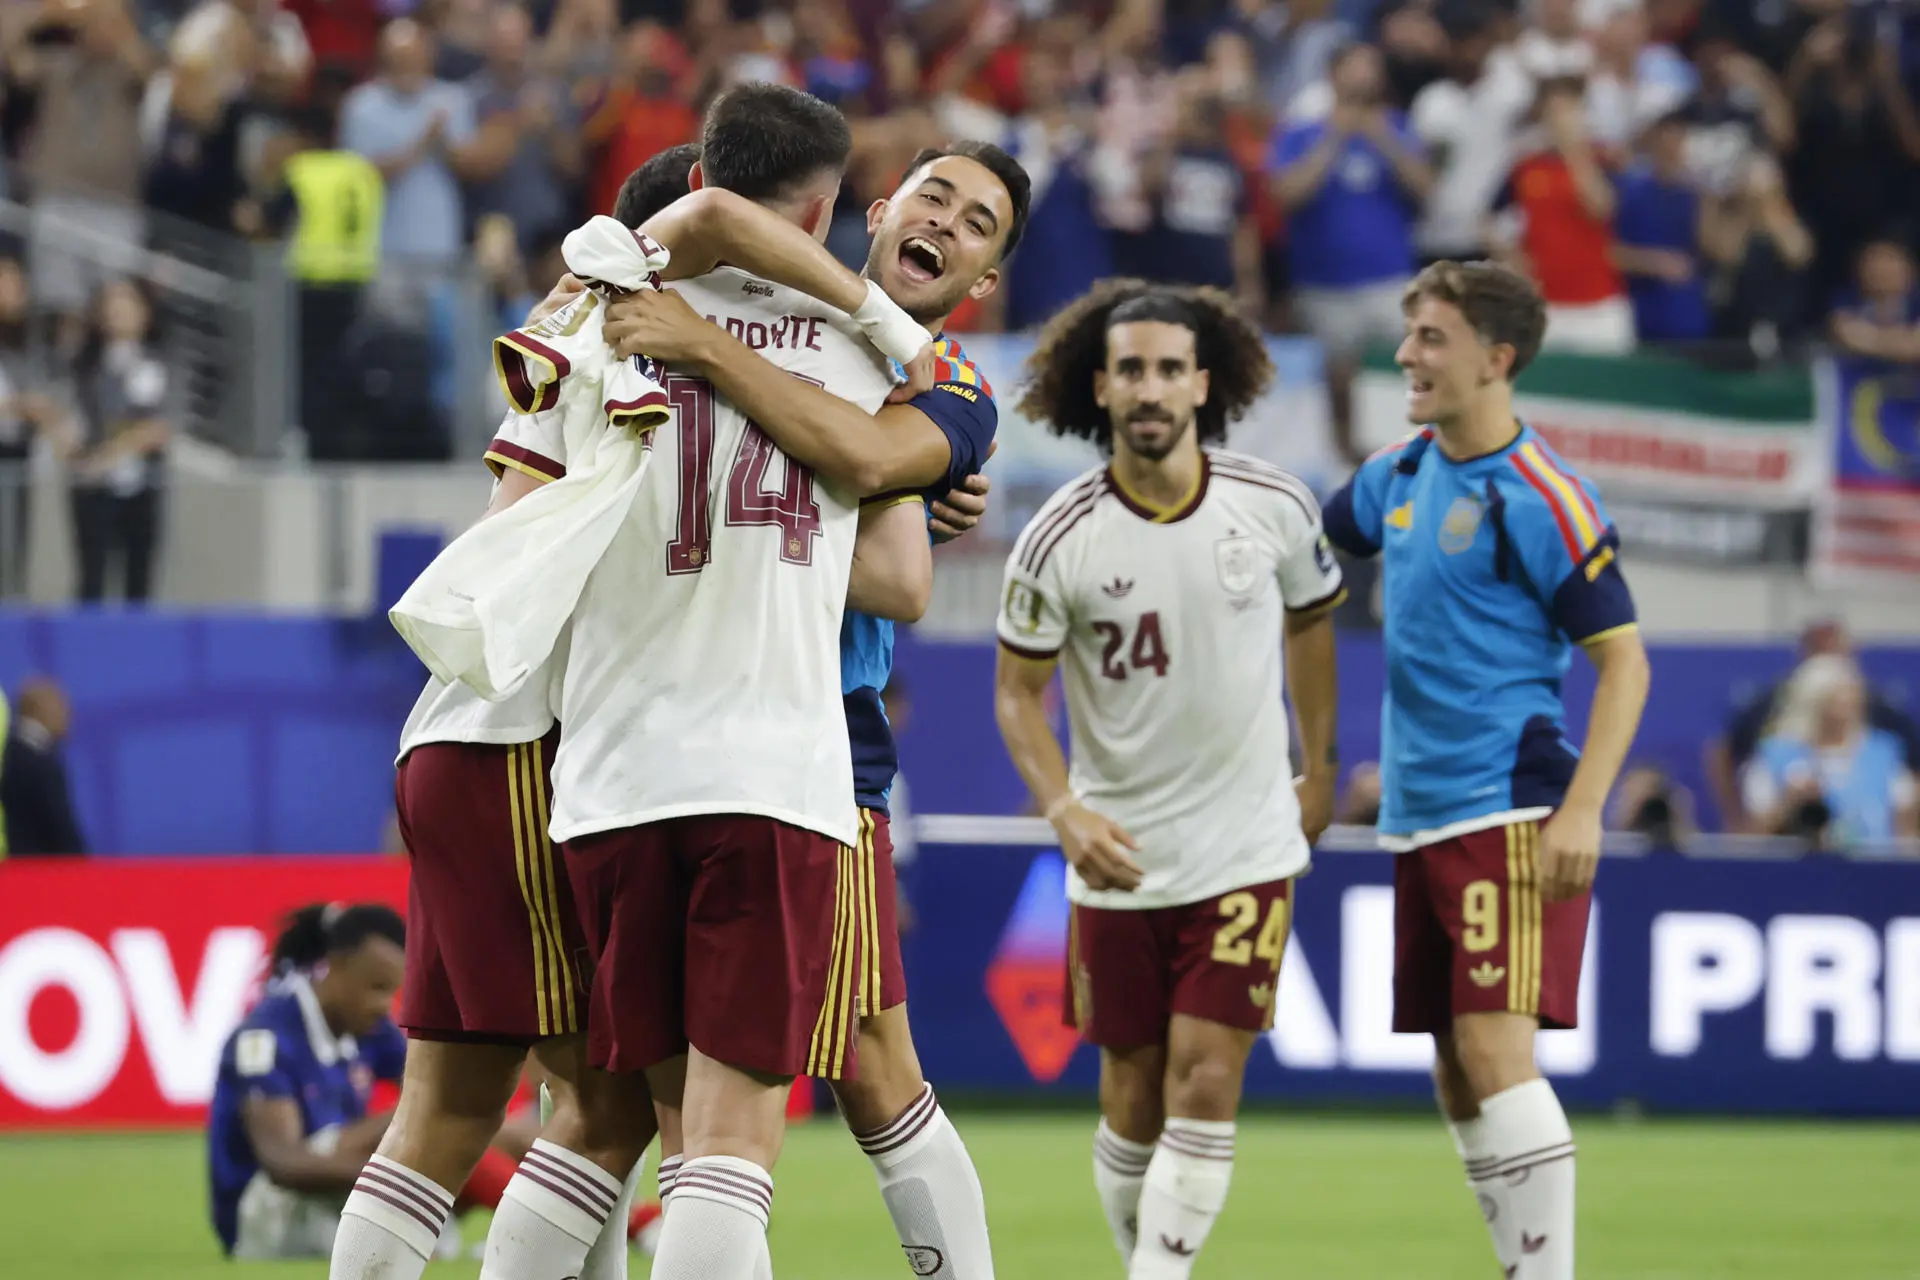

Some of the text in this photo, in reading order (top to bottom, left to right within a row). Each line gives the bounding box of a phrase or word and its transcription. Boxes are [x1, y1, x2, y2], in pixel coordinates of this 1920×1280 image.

[705, 314, 828, 352] PORTE
[666, 371, 825, 576] 14
[1092, 611, 1169, 680] 24
[1211, 891, 1286, 972] 24
[1461, 879, 1500, 952] 9
